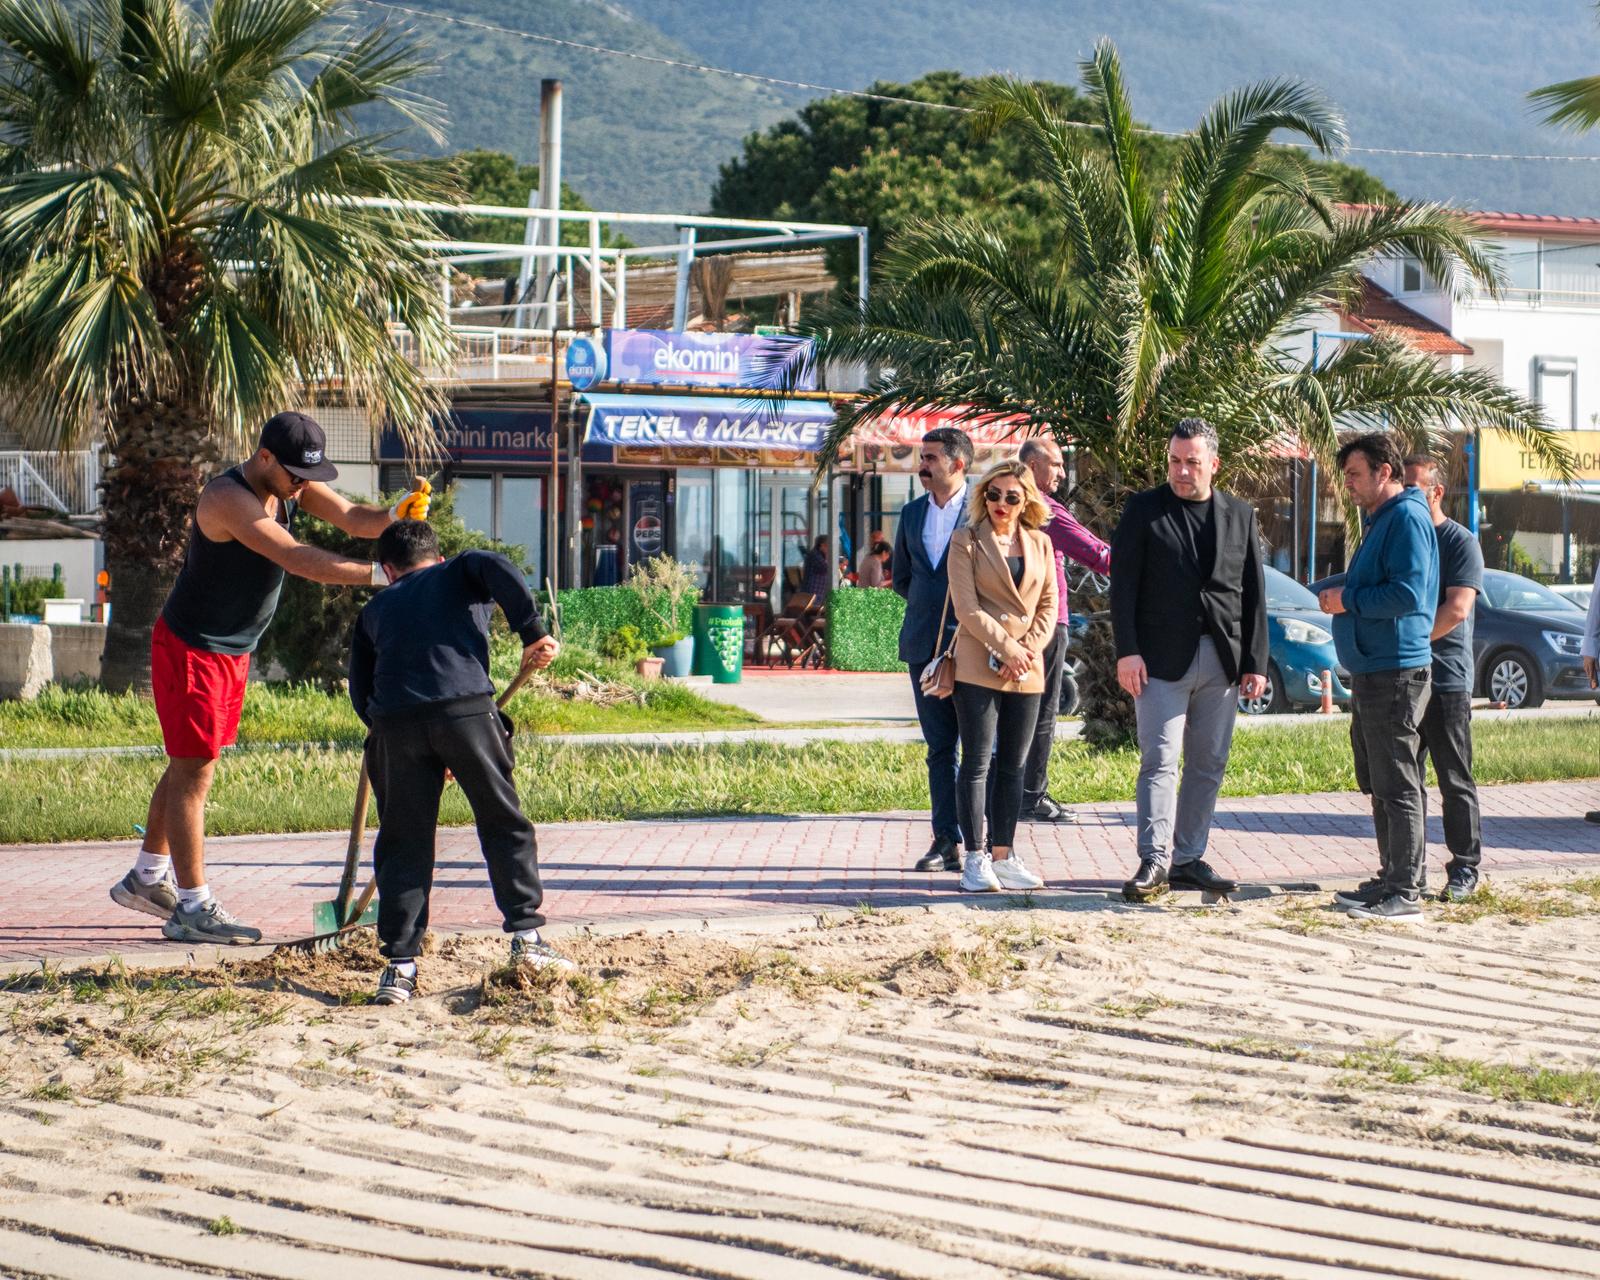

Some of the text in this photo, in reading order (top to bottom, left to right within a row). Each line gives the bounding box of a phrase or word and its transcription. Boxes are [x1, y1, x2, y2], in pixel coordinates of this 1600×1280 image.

[654, 341, 740, 371] ekomini
[491, 426, 558, 448] marke
[603, 415, 687, 439] TEKEL
[692, 416, 708, 438] &
[635, 529, 661, 538] PEPS
